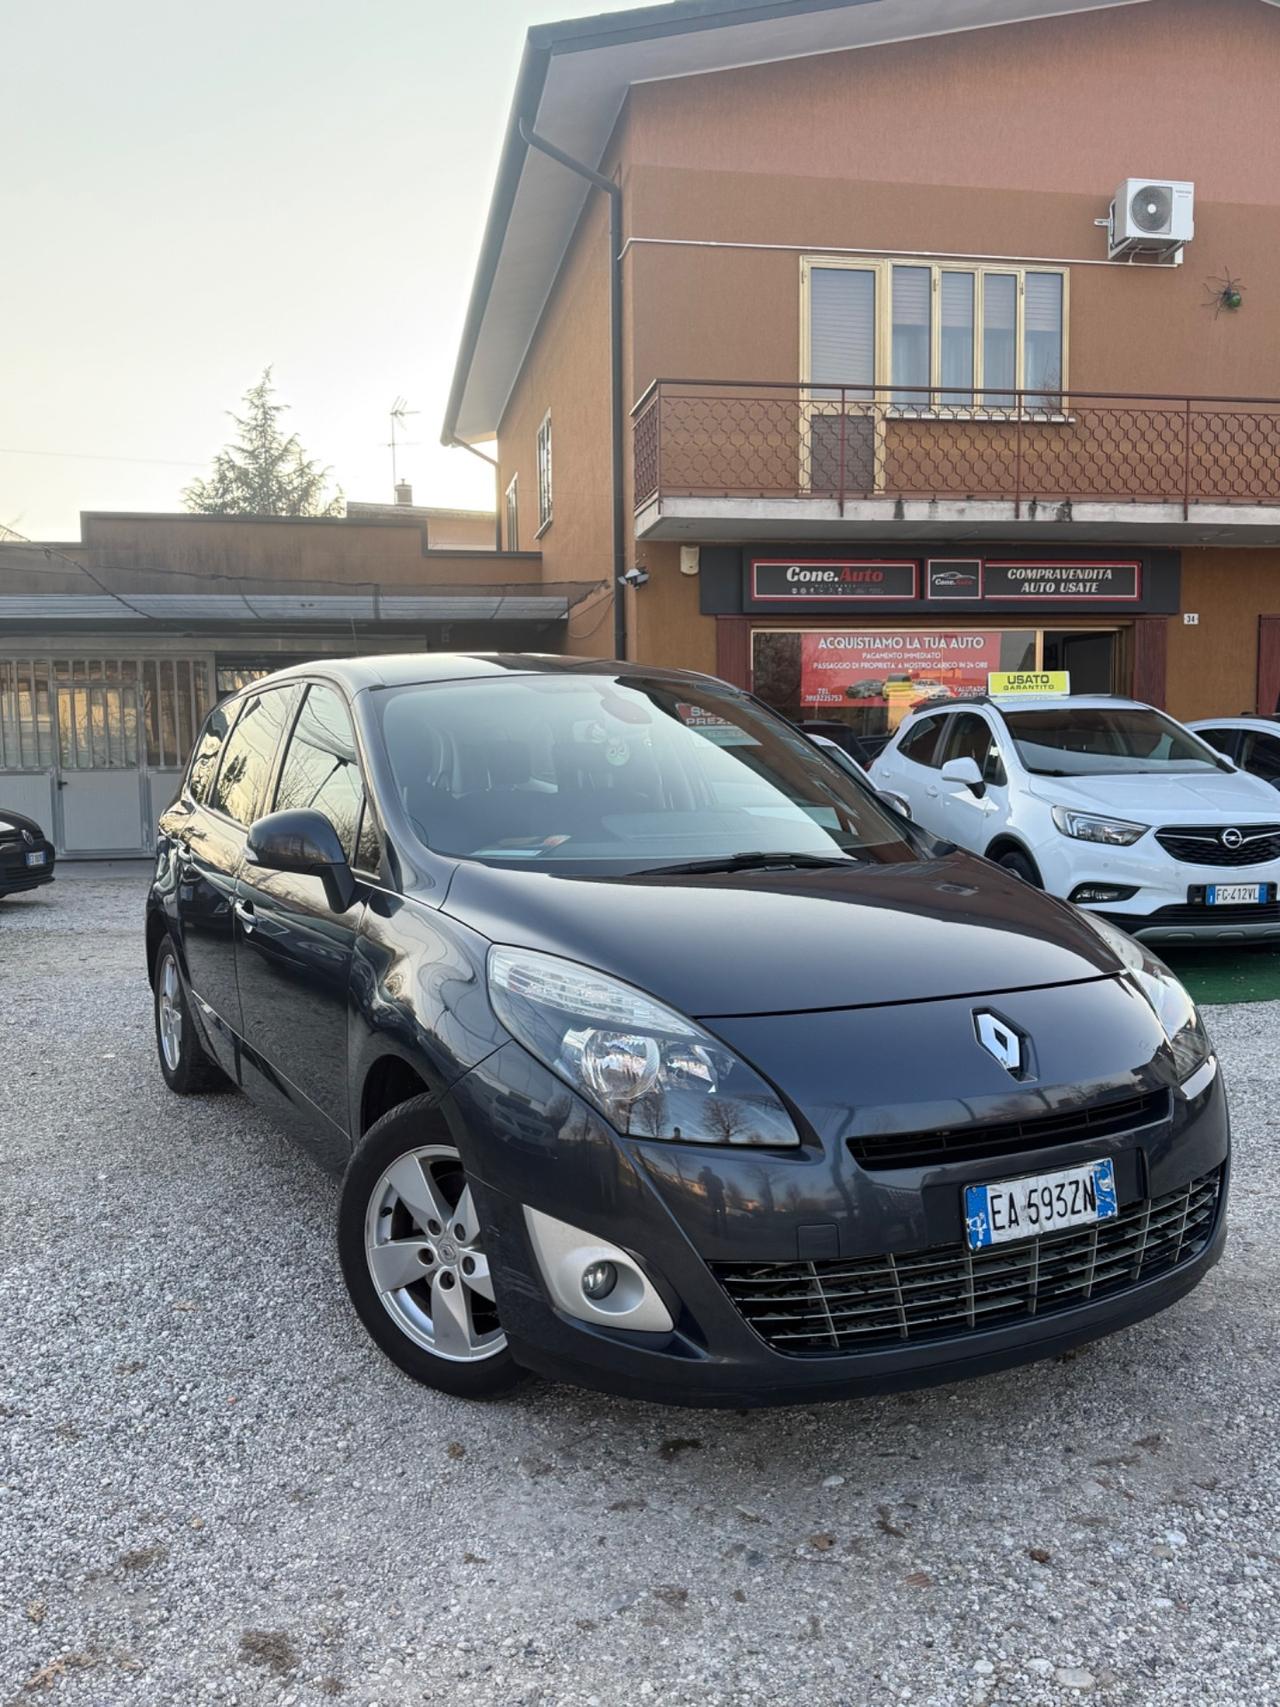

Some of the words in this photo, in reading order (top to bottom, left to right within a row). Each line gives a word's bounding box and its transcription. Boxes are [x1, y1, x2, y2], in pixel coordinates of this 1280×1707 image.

[1007, 568, 1113, 580] COMPRAVENDITA
[1020, 581, 1055, 593] AUTO
[1059, 581, 1100, 593] USATE
[818, 637, 903, 649] ACQUISTIAMO
[906, 637, 921, 649] LA
[923, 637, 947, 649] TUA
[950, 637, 984, 649] AUTO
[1007, 674, 1050, 685] USATO
